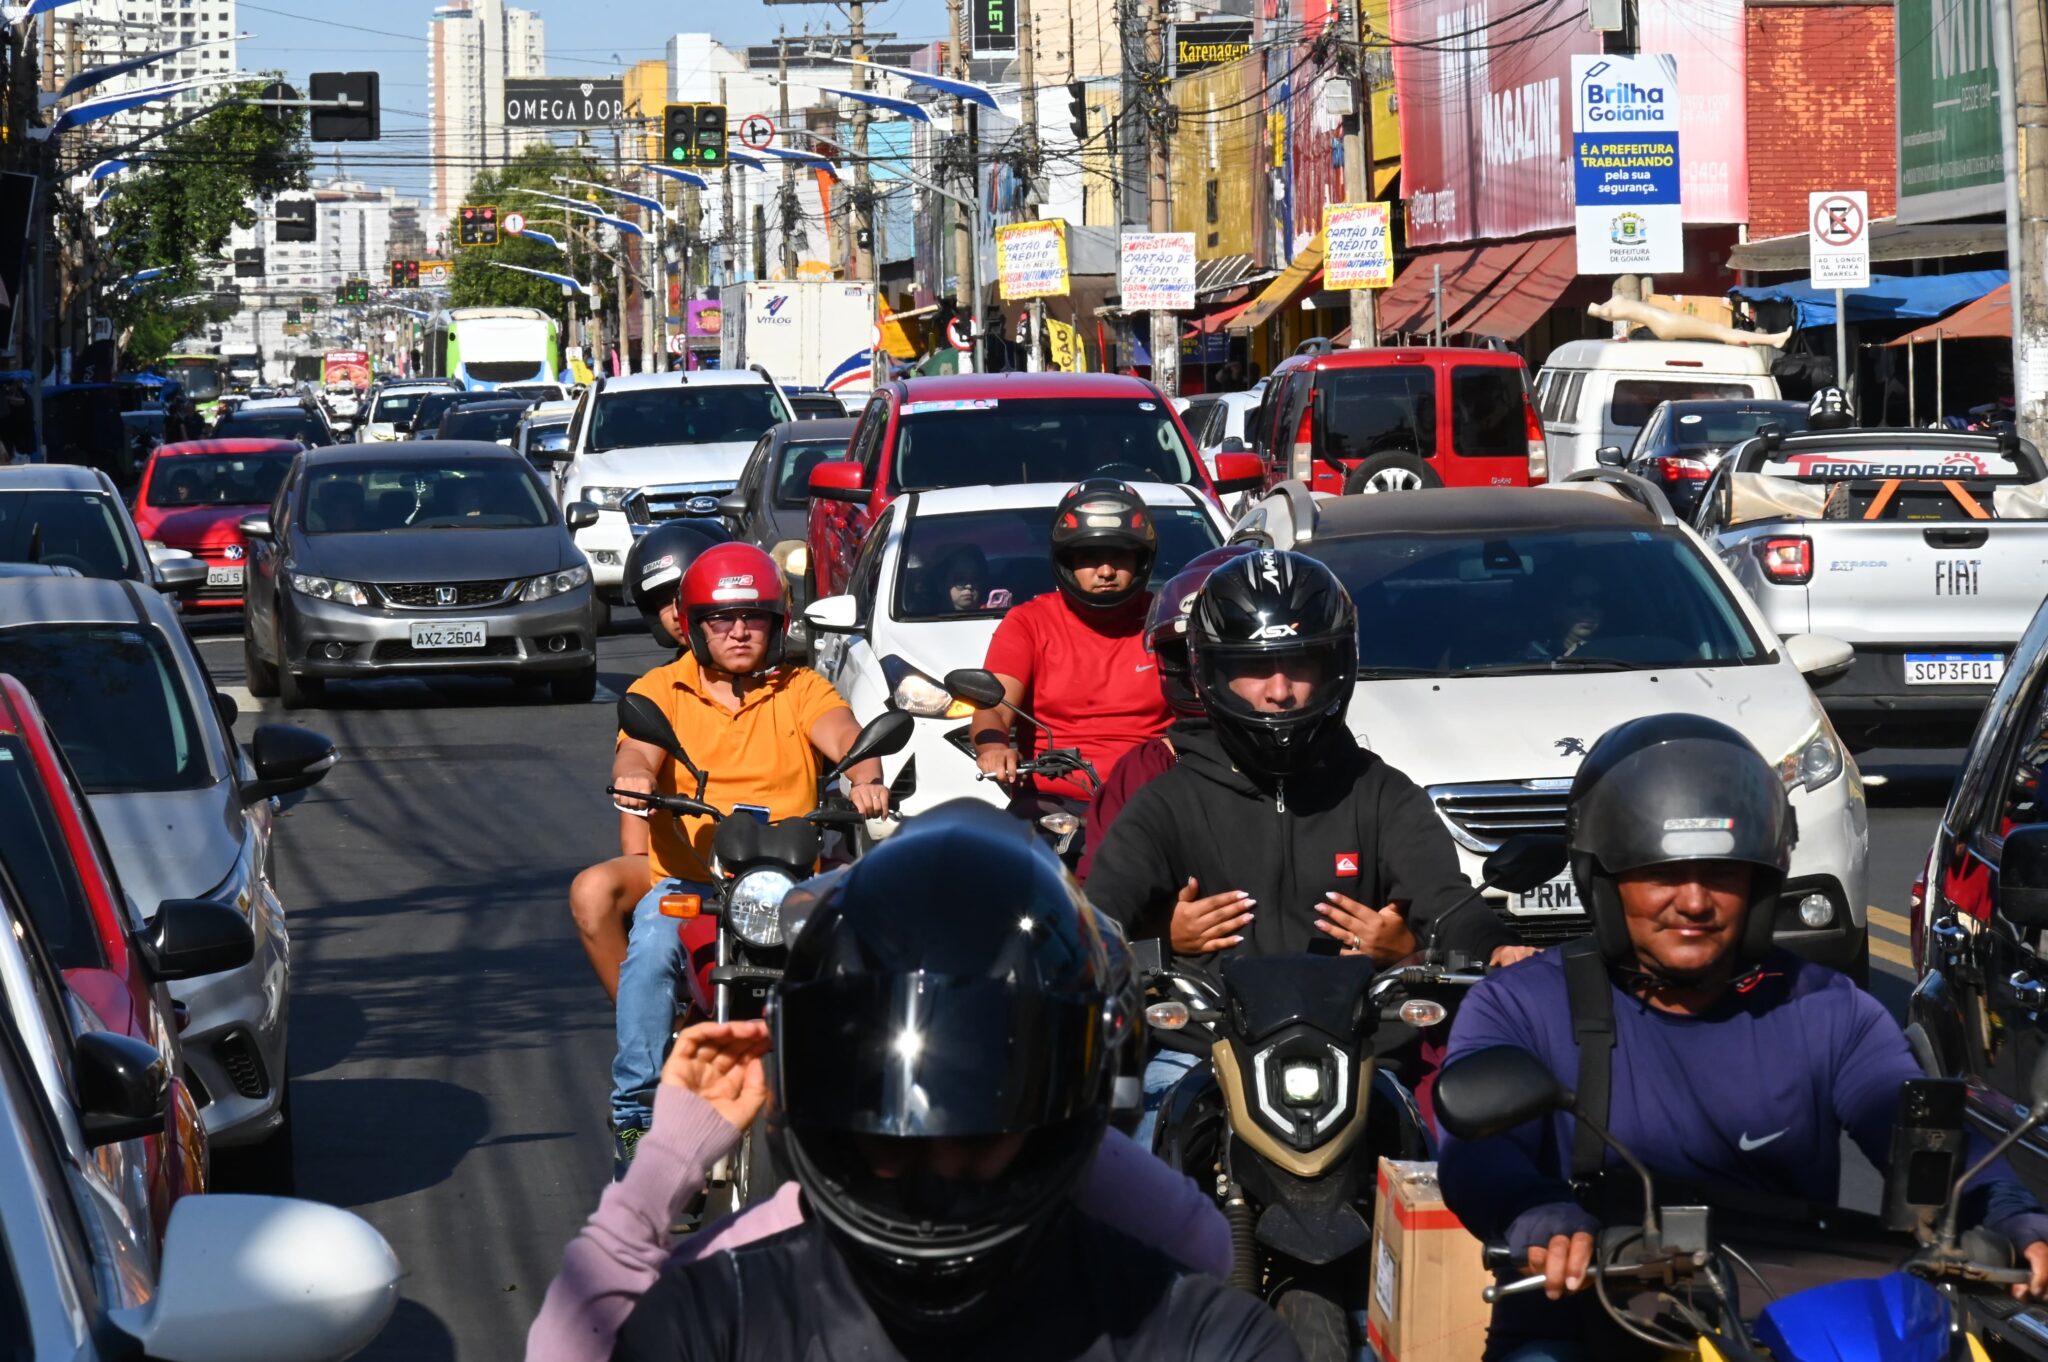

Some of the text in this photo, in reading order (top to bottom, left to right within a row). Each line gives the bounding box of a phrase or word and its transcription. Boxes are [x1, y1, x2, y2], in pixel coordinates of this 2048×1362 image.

[1587, 82, 1664, 104] Brilha
[507, 99, 577, 120] OMEGA
[1588, 105, 1664, 121] Goiânia
[1481, 77, 1561, 166] MAGAZINE
[1580, 143, 1674, 155] É A PREFEITURA
[1581, 156, 1674, 168] TRABALHANDO
[1605, 169, 1651, 183] pela sua
[1598, 183, 1658, 195] segurança.
[1325, 225, 1387, 239] CARTÃO DE
[1045, 240, 1059, 249] DE
[1329, 239, 1378, 252] CRÉDITO
[1124, 252, 1191, 264] CARTÃO DE
[1621, 255, 1650, 263] GOIÂNIA
[1129, 263, 1180, 276] CRÉDITO
[1831, 560, 1888, 568] STRADA
[210, 573, 230, 583] OGJ
[1935, 559, 1981, 596] FIAT
[1248, 622, 1299, 639] ASX
[1915, 663, 1993, 680] SCP3F01
